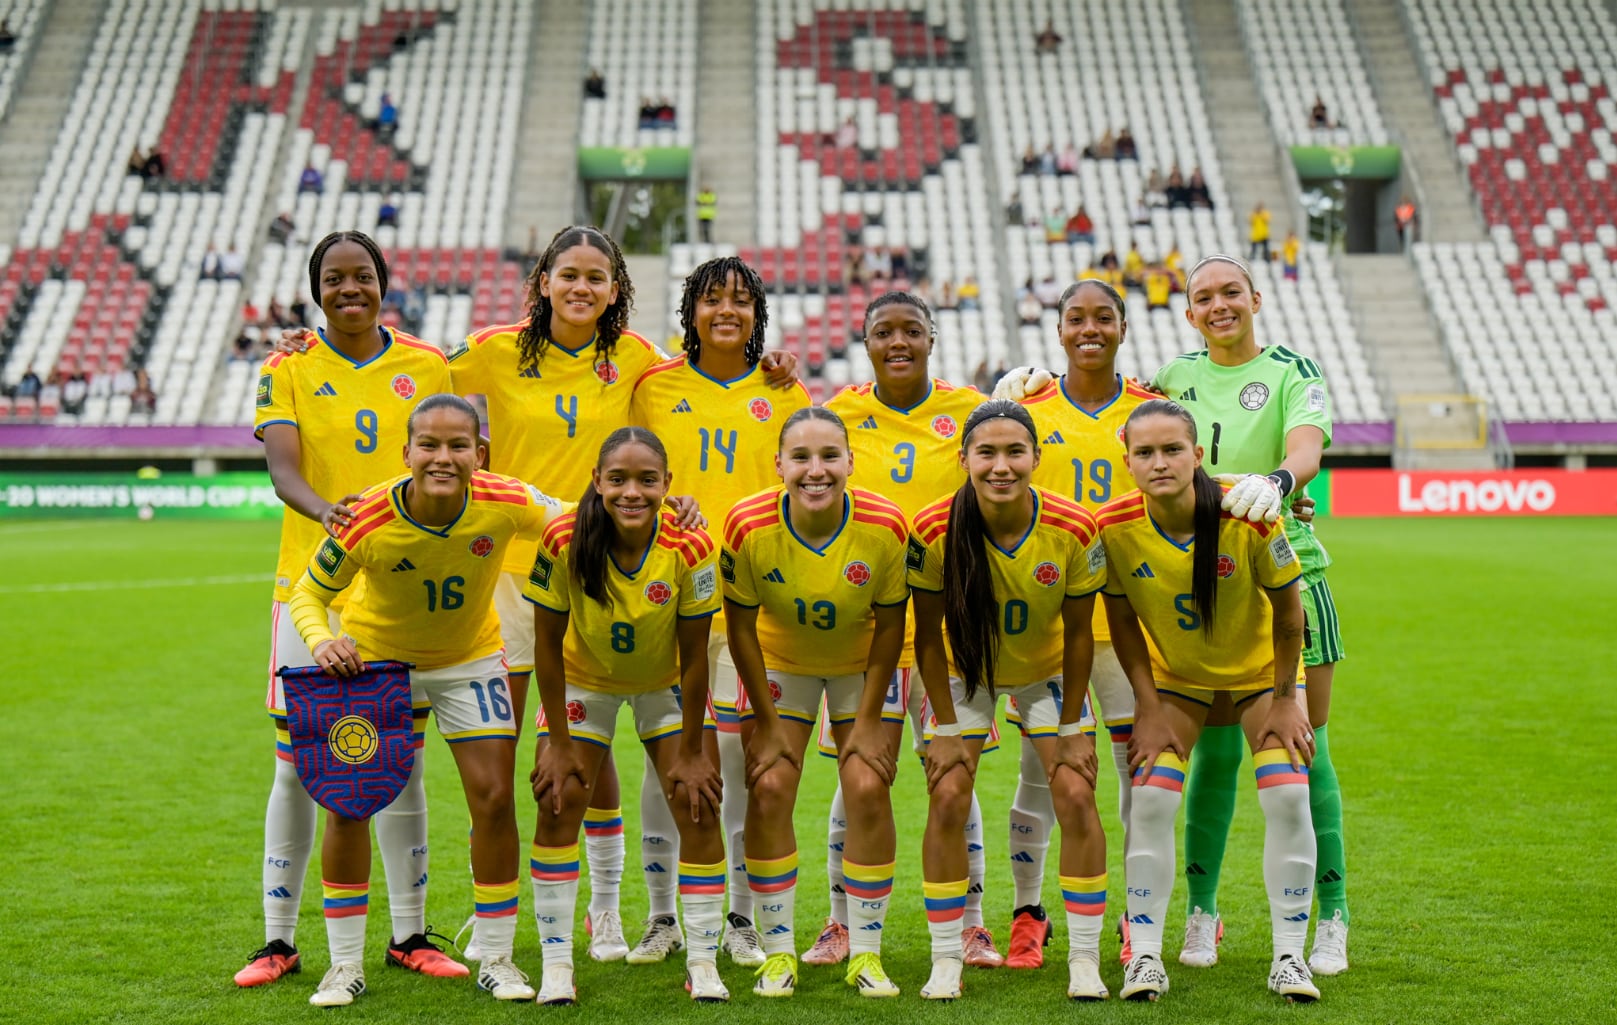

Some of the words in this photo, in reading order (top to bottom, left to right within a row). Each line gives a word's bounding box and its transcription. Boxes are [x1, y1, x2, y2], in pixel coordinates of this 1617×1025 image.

[355, 409, 378, 454] 9
[555, 394, 577, 438] 4
[699, 428, 738, 473] 14
[1210, 422, 1221, 466] 1
[890, 442, 916, 483] 3
[1071, 458, 1112, 502] 19
[36, 485, 130, 507] WOMEN'S
[131, 485, 205, 507] WORLD
[207, 485, 248, 507] CUP
[1398, 474, 1555, 511] Lenovo
[423, 576, 465, 612] 16
[794, 597, 836, 630] 13
[995, 600, 1028, 635] 0
[611, 622, 635, 654] 8
[470, 677, 511, 723] 16
[1011, 823, 1033, 834] FCF
[268, 857, 291, 868] FCF
[762, 903, 784, 913] FCF
[861, 901, 884, 910] FCF
[1127, 887, 1151, 898] FCF
[1284, 887, 1309, 897] FCF
